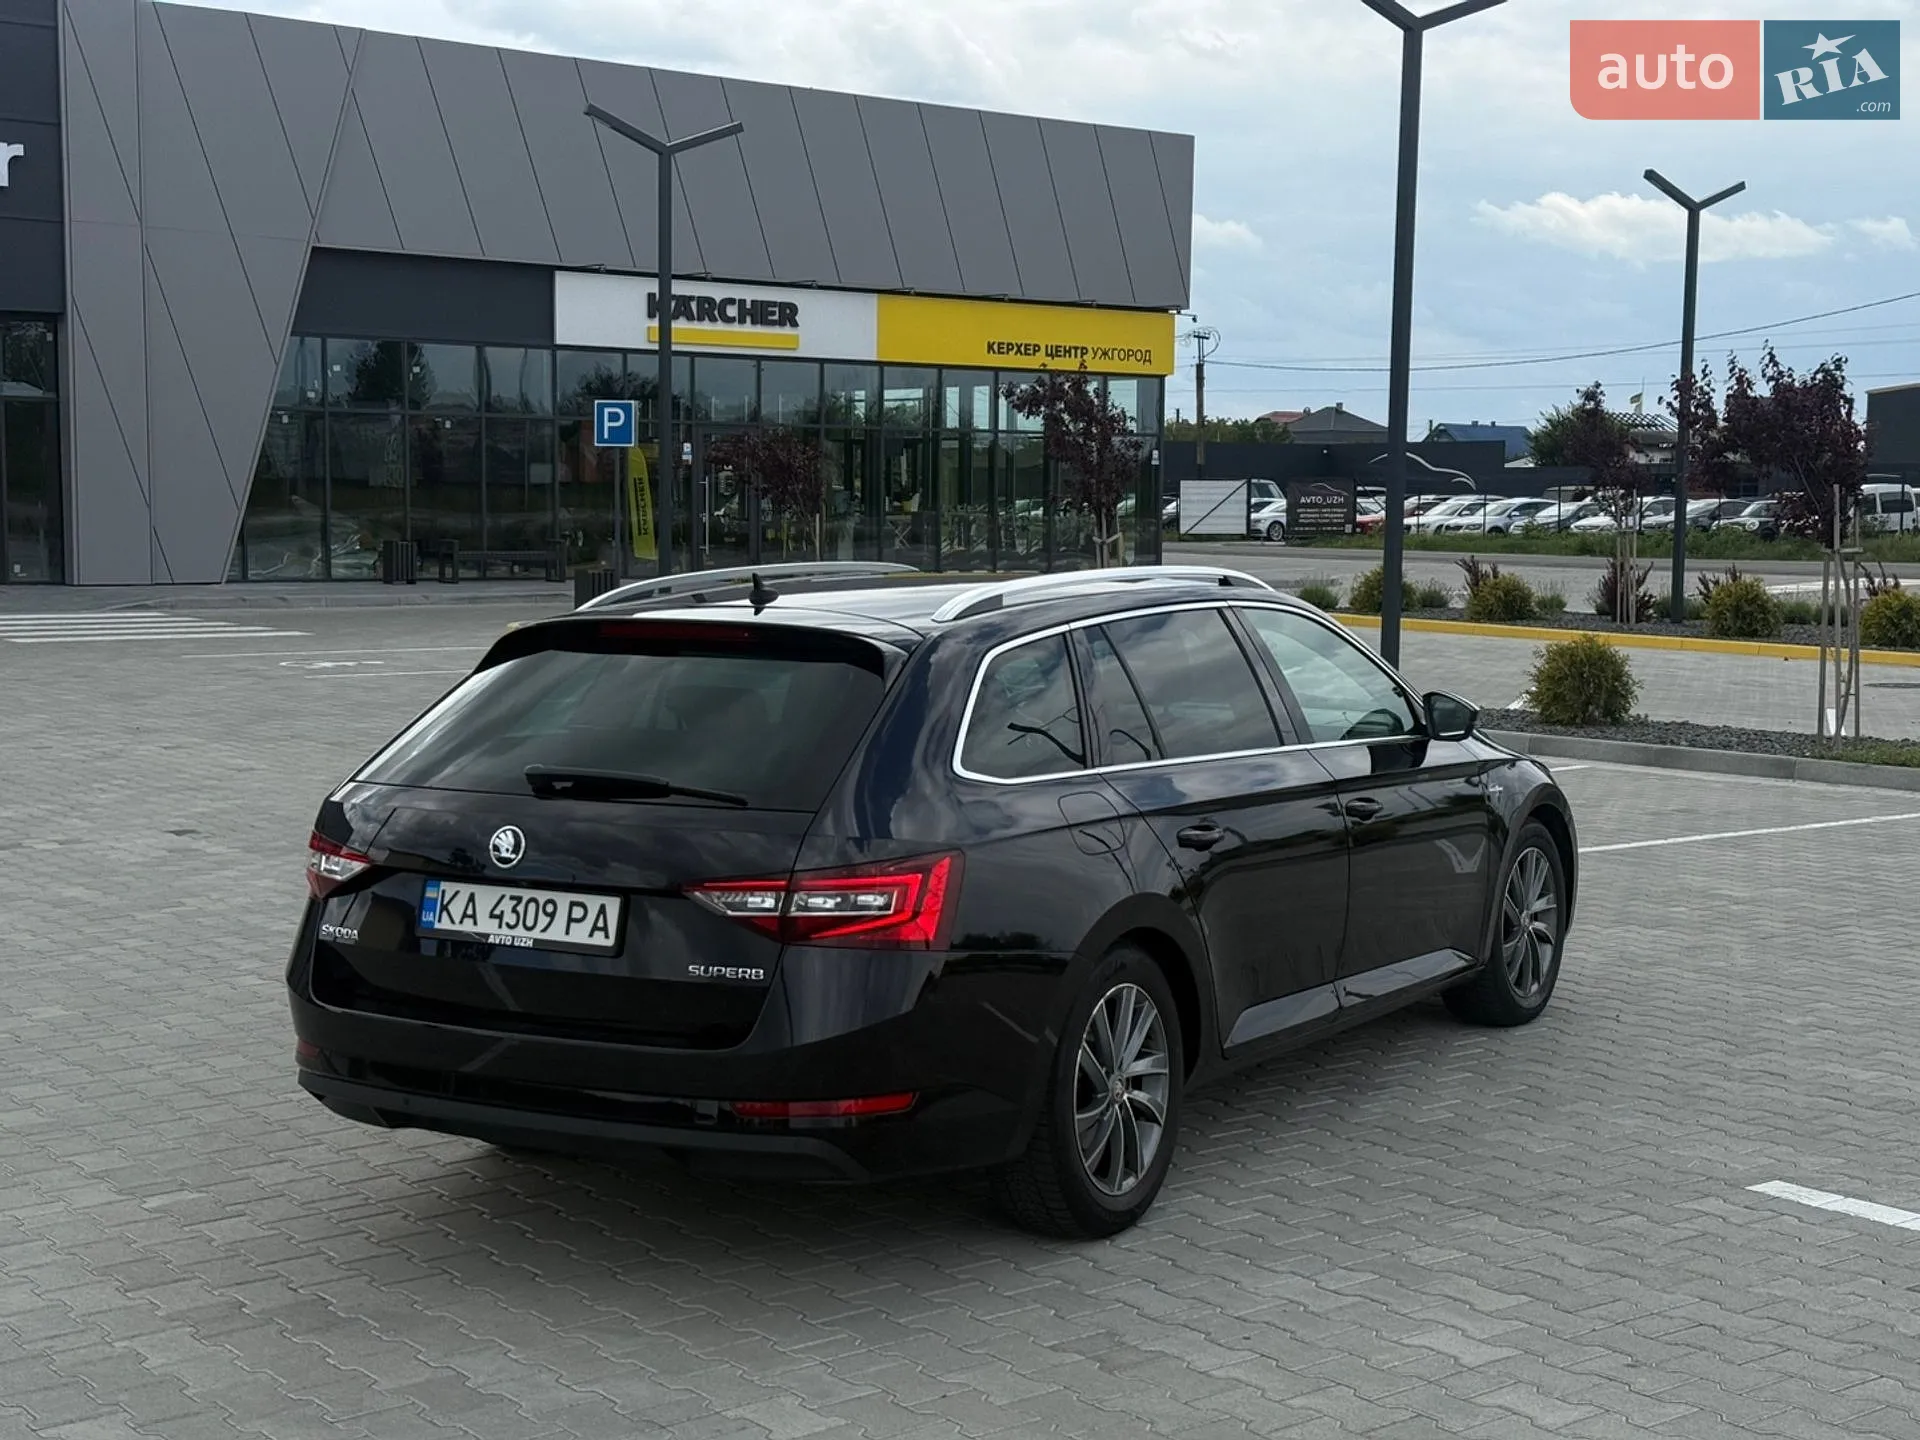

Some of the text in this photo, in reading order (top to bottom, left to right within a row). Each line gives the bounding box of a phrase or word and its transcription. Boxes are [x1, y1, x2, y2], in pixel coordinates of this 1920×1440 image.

[986, 341, 1152, 366] КЕРХЕР ЦЕНТР УЖГОРОД
[604, 407, 625, 439] P
[422, 911, 434, 921] UA
[438, 889, 610, 940] KA 4309 PA
[488, 934, 534, 948] AVTO UZH
[688, 965, 764, 980] SUPERB
